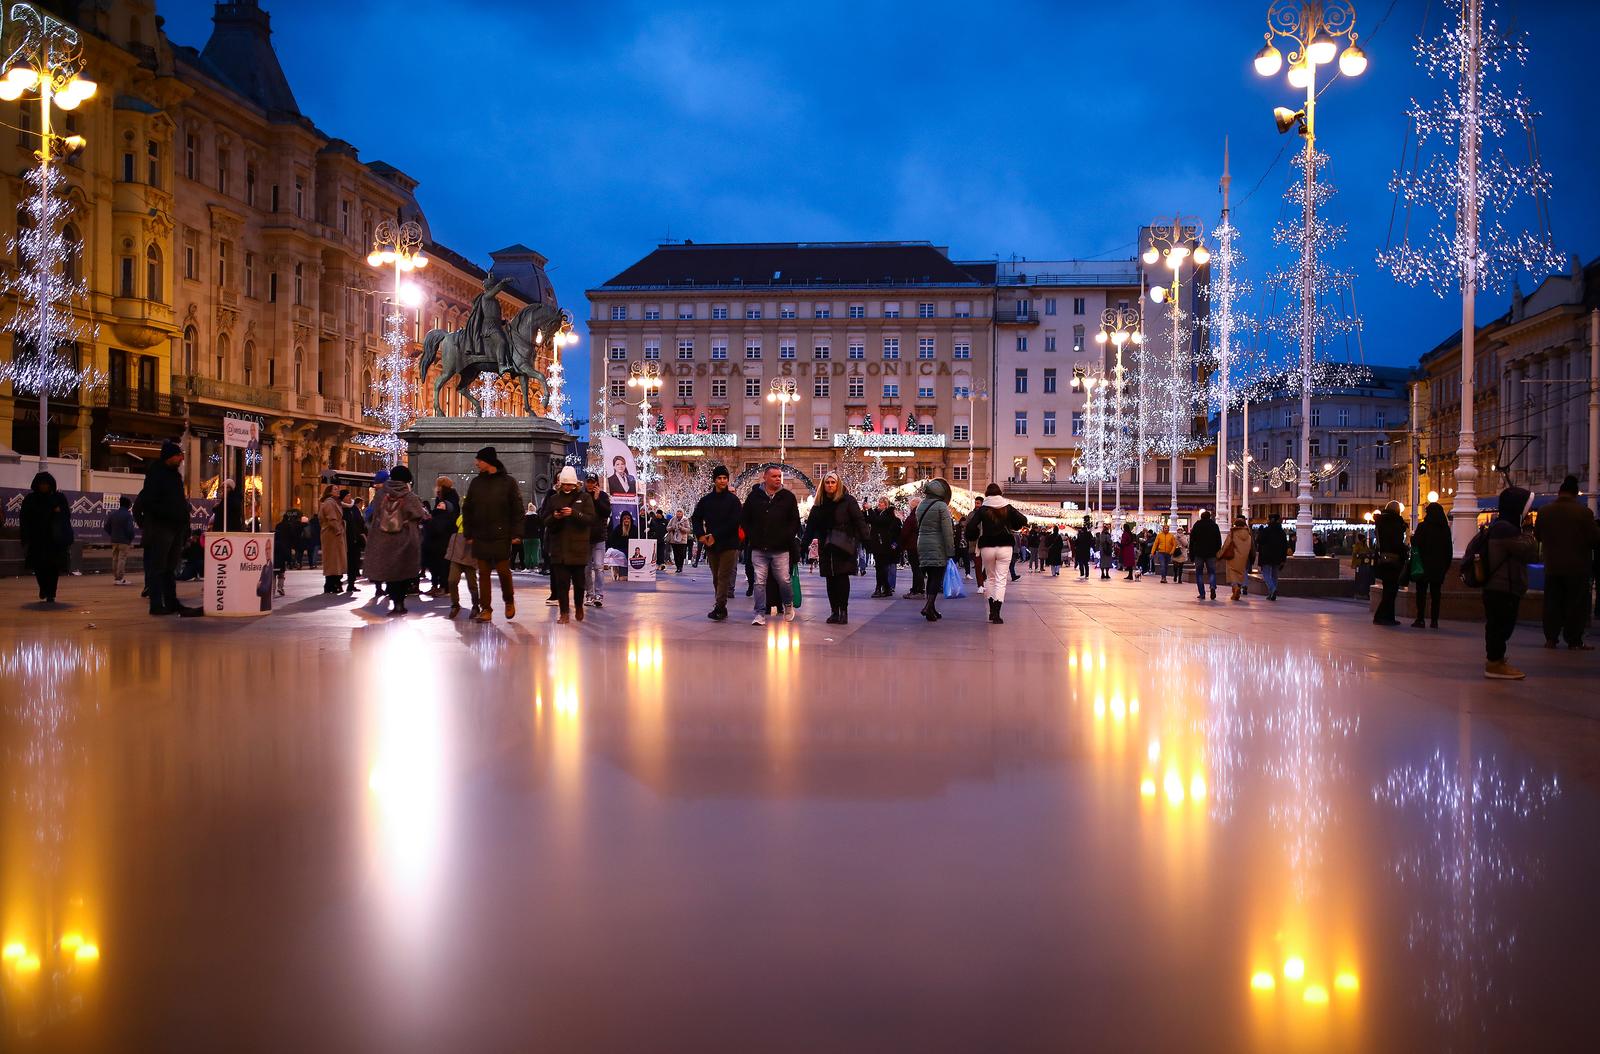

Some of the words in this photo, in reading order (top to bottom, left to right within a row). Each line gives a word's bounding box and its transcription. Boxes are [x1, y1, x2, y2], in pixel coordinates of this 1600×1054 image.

[214, 545, 229, 557] ZA
[246, 546, 257, 557] ZA
[239, 562, 263, 572] Mislava
[216, 563, 228, 611] Mislava
